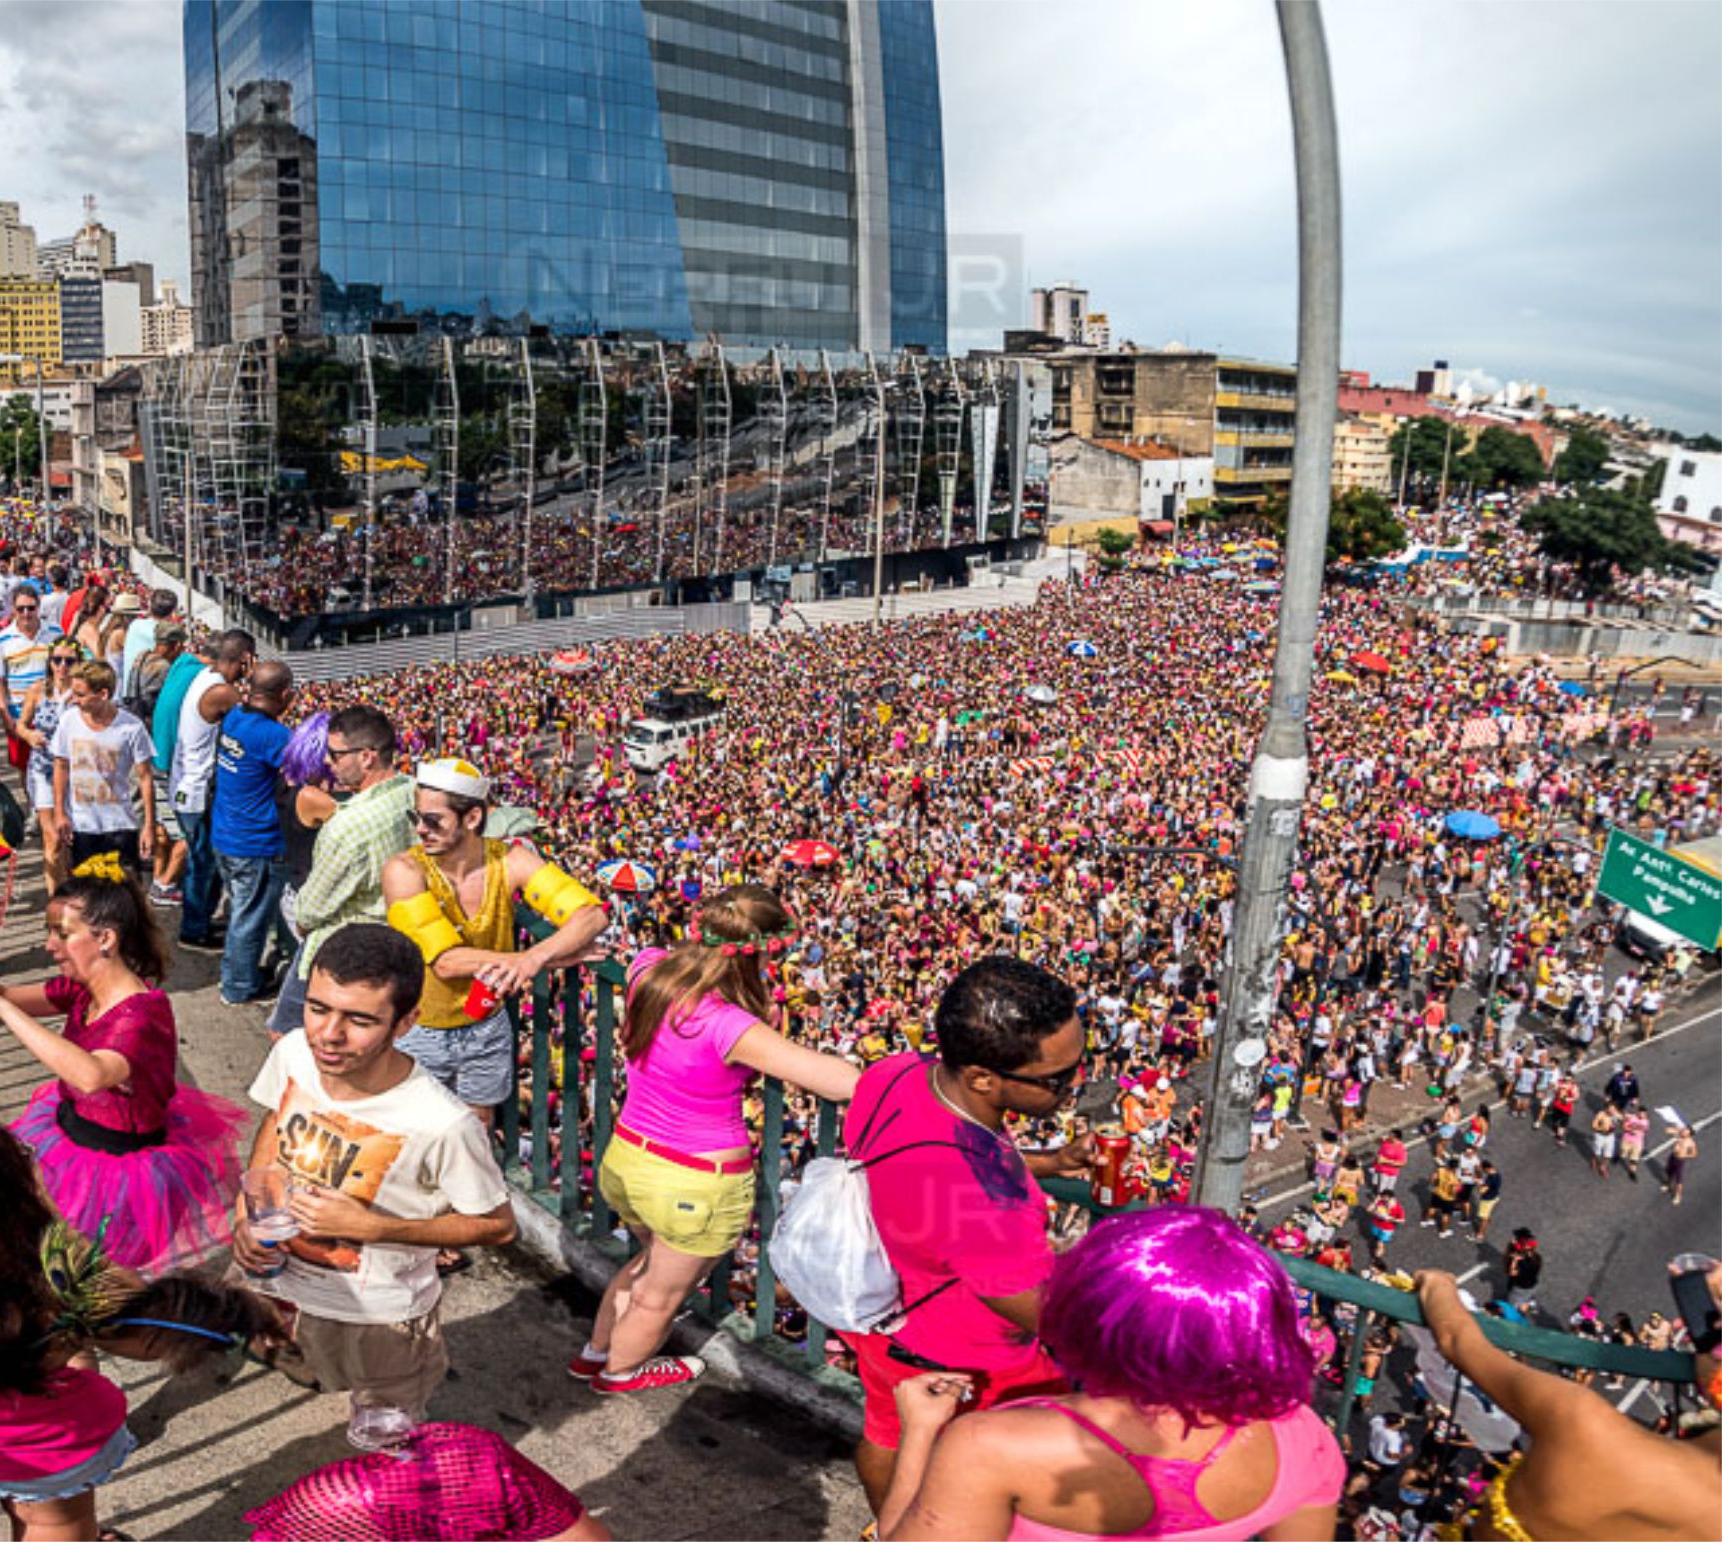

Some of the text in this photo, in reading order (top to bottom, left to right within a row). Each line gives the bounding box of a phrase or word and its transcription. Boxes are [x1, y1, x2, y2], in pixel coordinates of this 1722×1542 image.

[1632, 864, 1697, 906] Pampulha
[1678, 869, 1721, 900] Carlos
[279, 1113, 361, 1188] SUN
